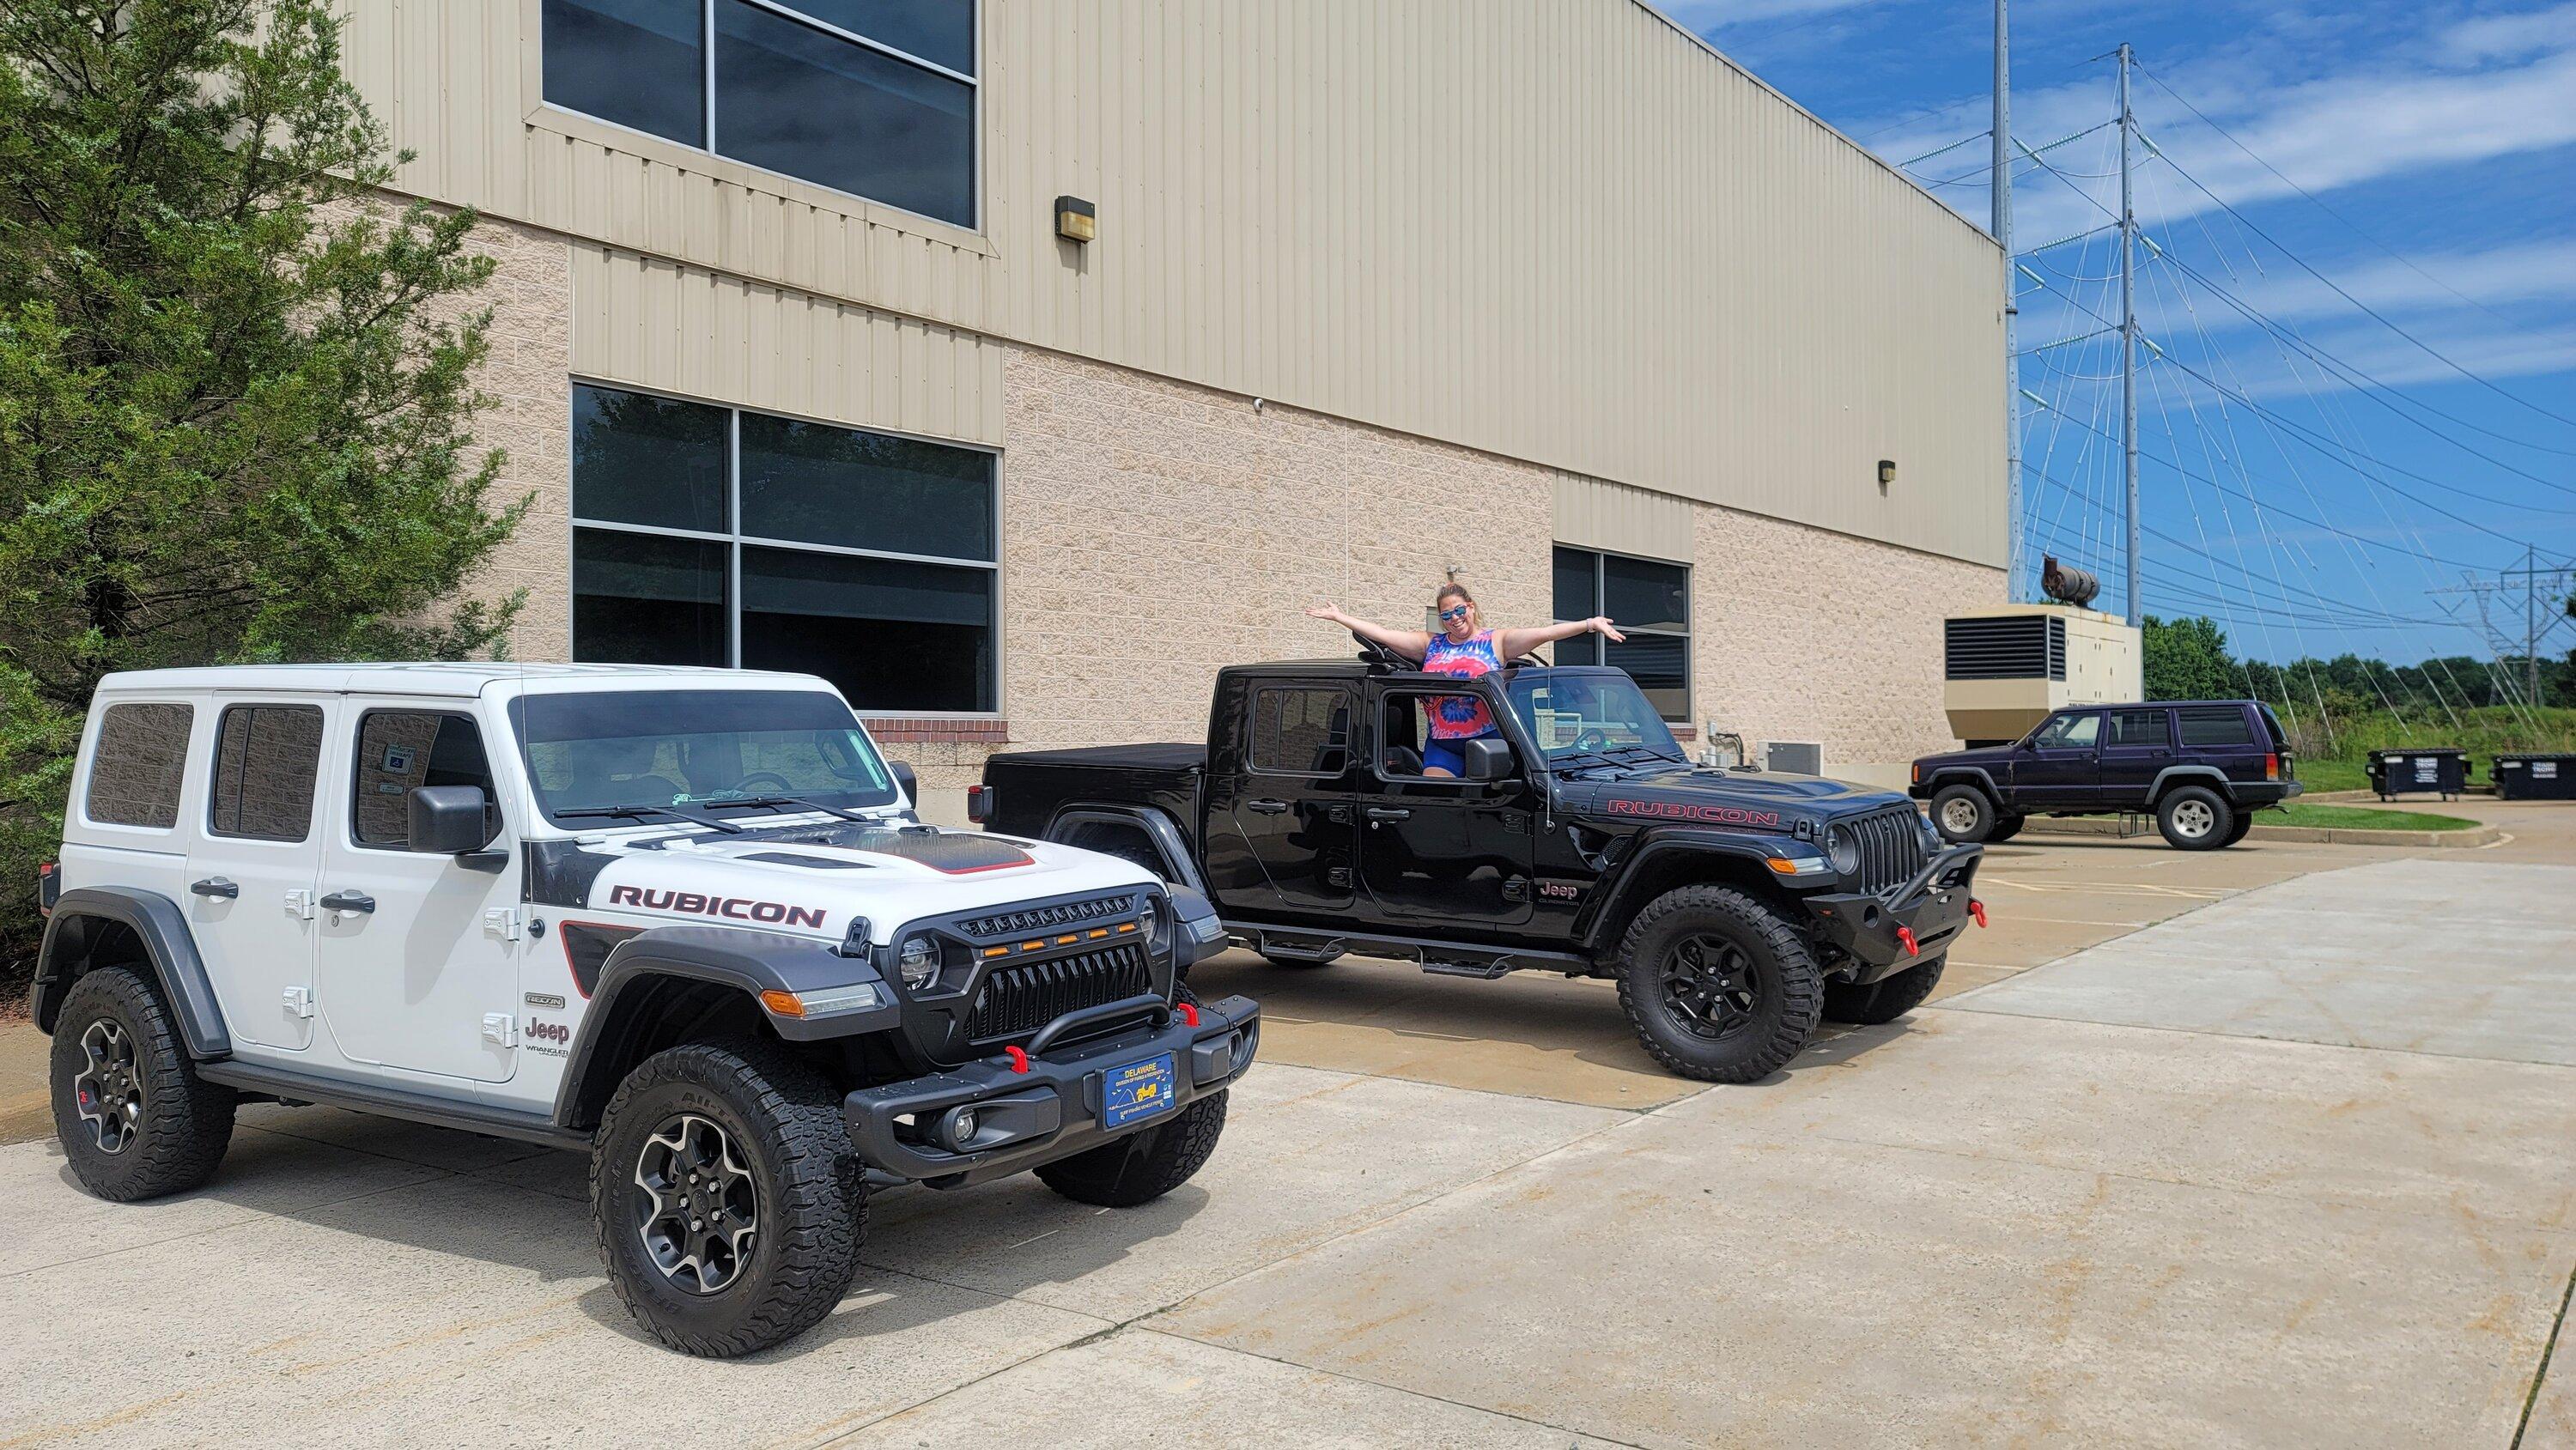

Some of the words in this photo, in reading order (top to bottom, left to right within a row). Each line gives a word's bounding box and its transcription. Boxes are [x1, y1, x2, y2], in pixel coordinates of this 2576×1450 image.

[1607, 799, 1778, 826] RUBICON
[1540, 881, 1577, 900] Jeep
[609, 884, 828, 930] RUBICON
[526, 996, 562, 1005] RECON
[525, 1016, 569, 1045] Jeep
[526, 1045, 568, 1056] WRANGLER
[1125, 1063, 1157, 1078] DELAWARE
